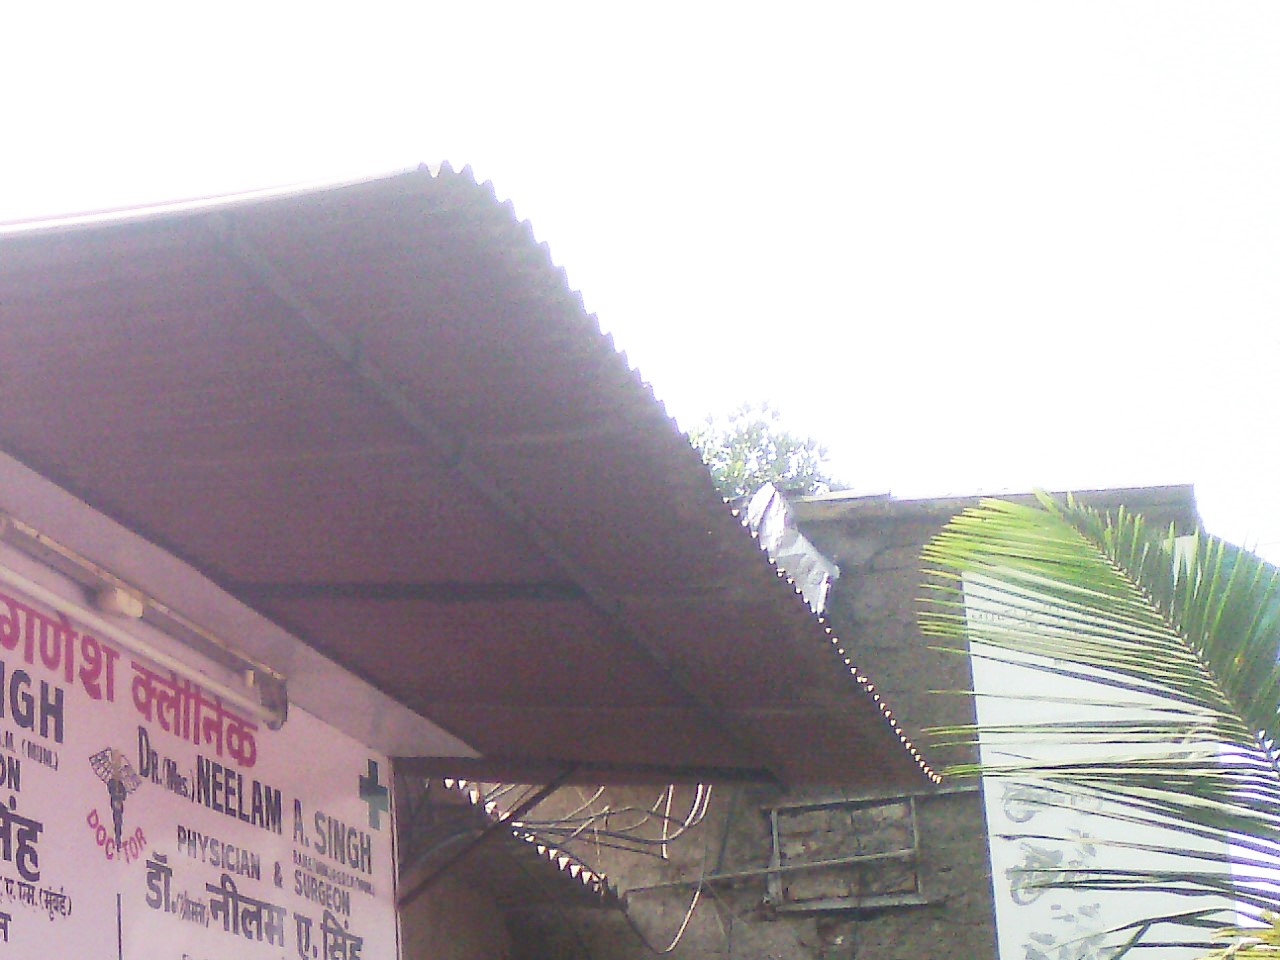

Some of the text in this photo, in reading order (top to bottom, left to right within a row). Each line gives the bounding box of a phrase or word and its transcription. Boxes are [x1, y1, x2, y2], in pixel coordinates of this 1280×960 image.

[87, 809, 147, 863] DOCTOR
[197, 755, 283, 835] NEELAM
[314, 810, 372, 874] SINGH
[177, 825, 261, 880] PHYSICIAN
[294, 869, 350, 916] SURGEON
[205, 873, 287, 947] नीलम
